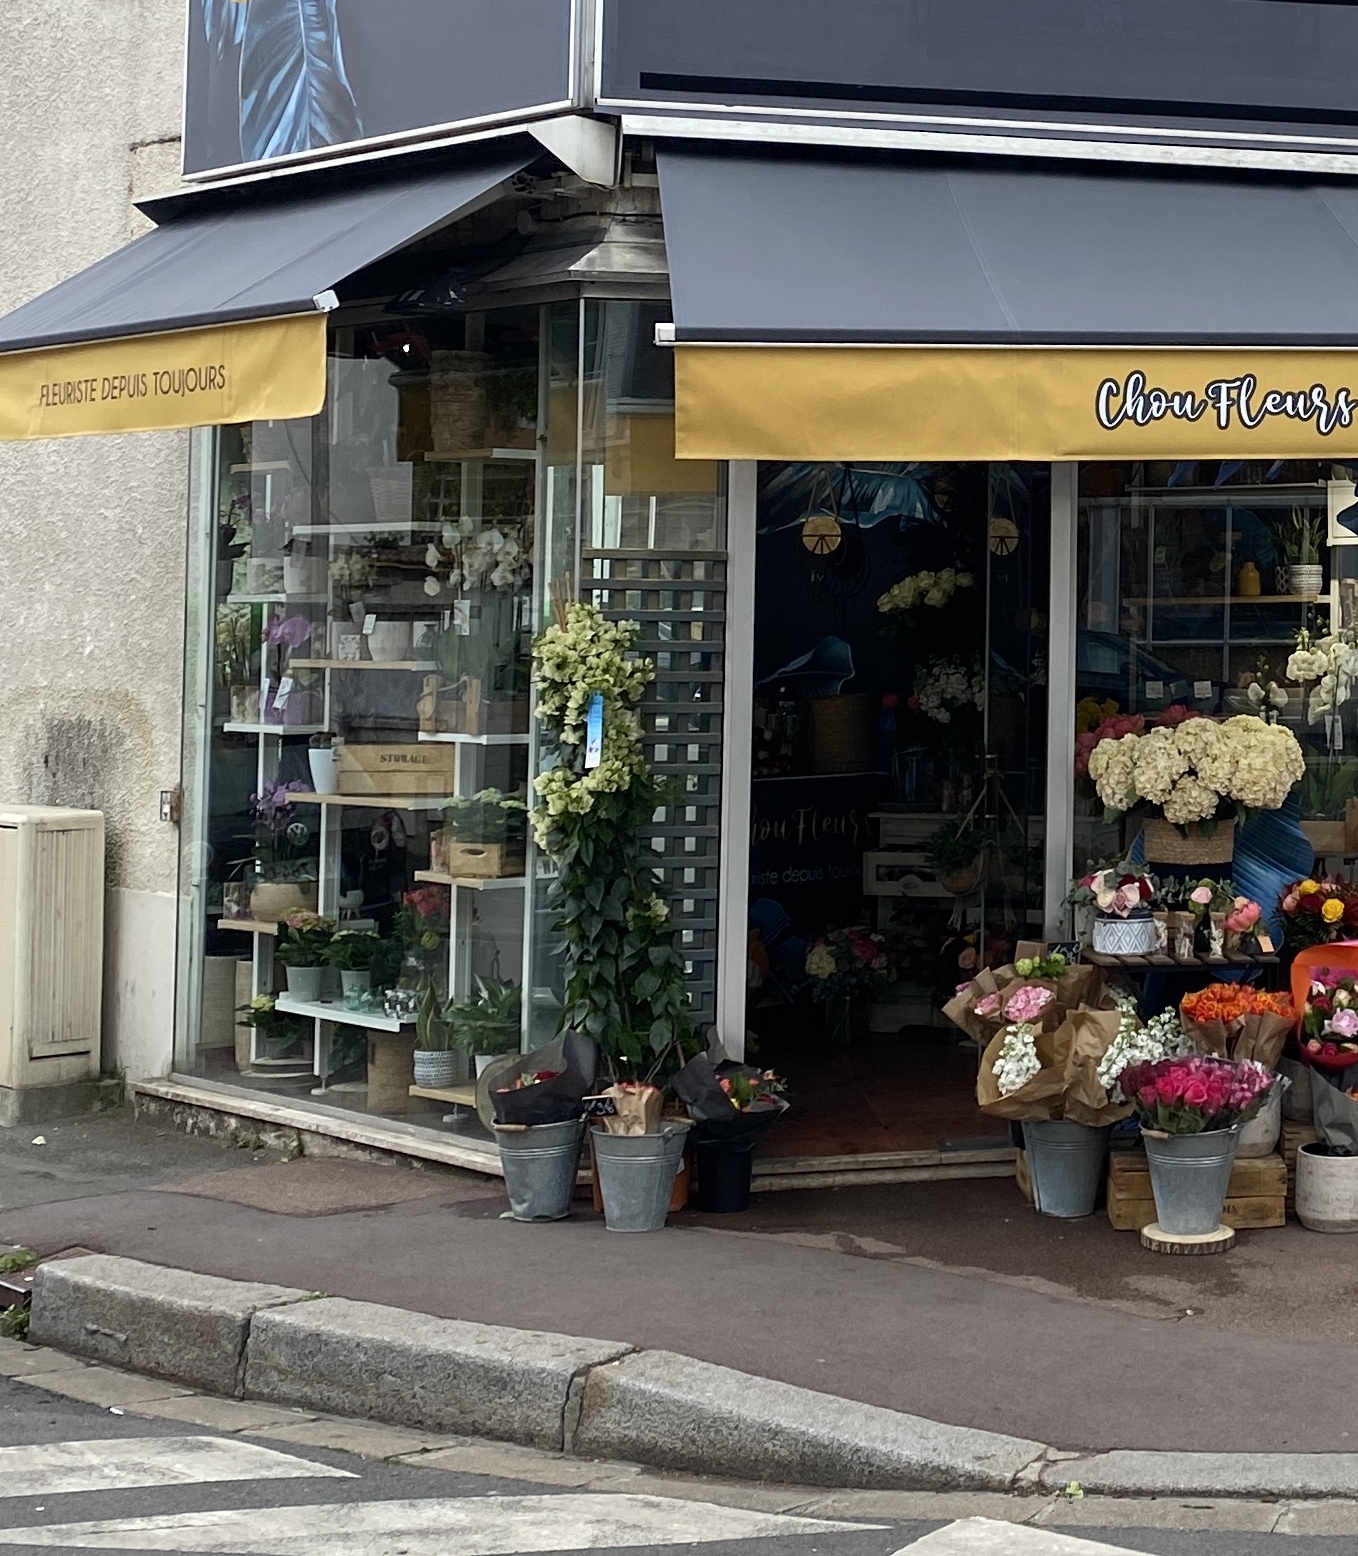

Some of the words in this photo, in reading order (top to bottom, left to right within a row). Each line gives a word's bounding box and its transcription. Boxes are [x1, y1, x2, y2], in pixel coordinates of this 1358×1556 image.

[39, 378, 97, 406] FLEURISTE
[101, 373, 147, 400] DEPUIS
[153, 364, 226, 397] TOUJOURS
[1095, 370, 1207, 430] Chou
